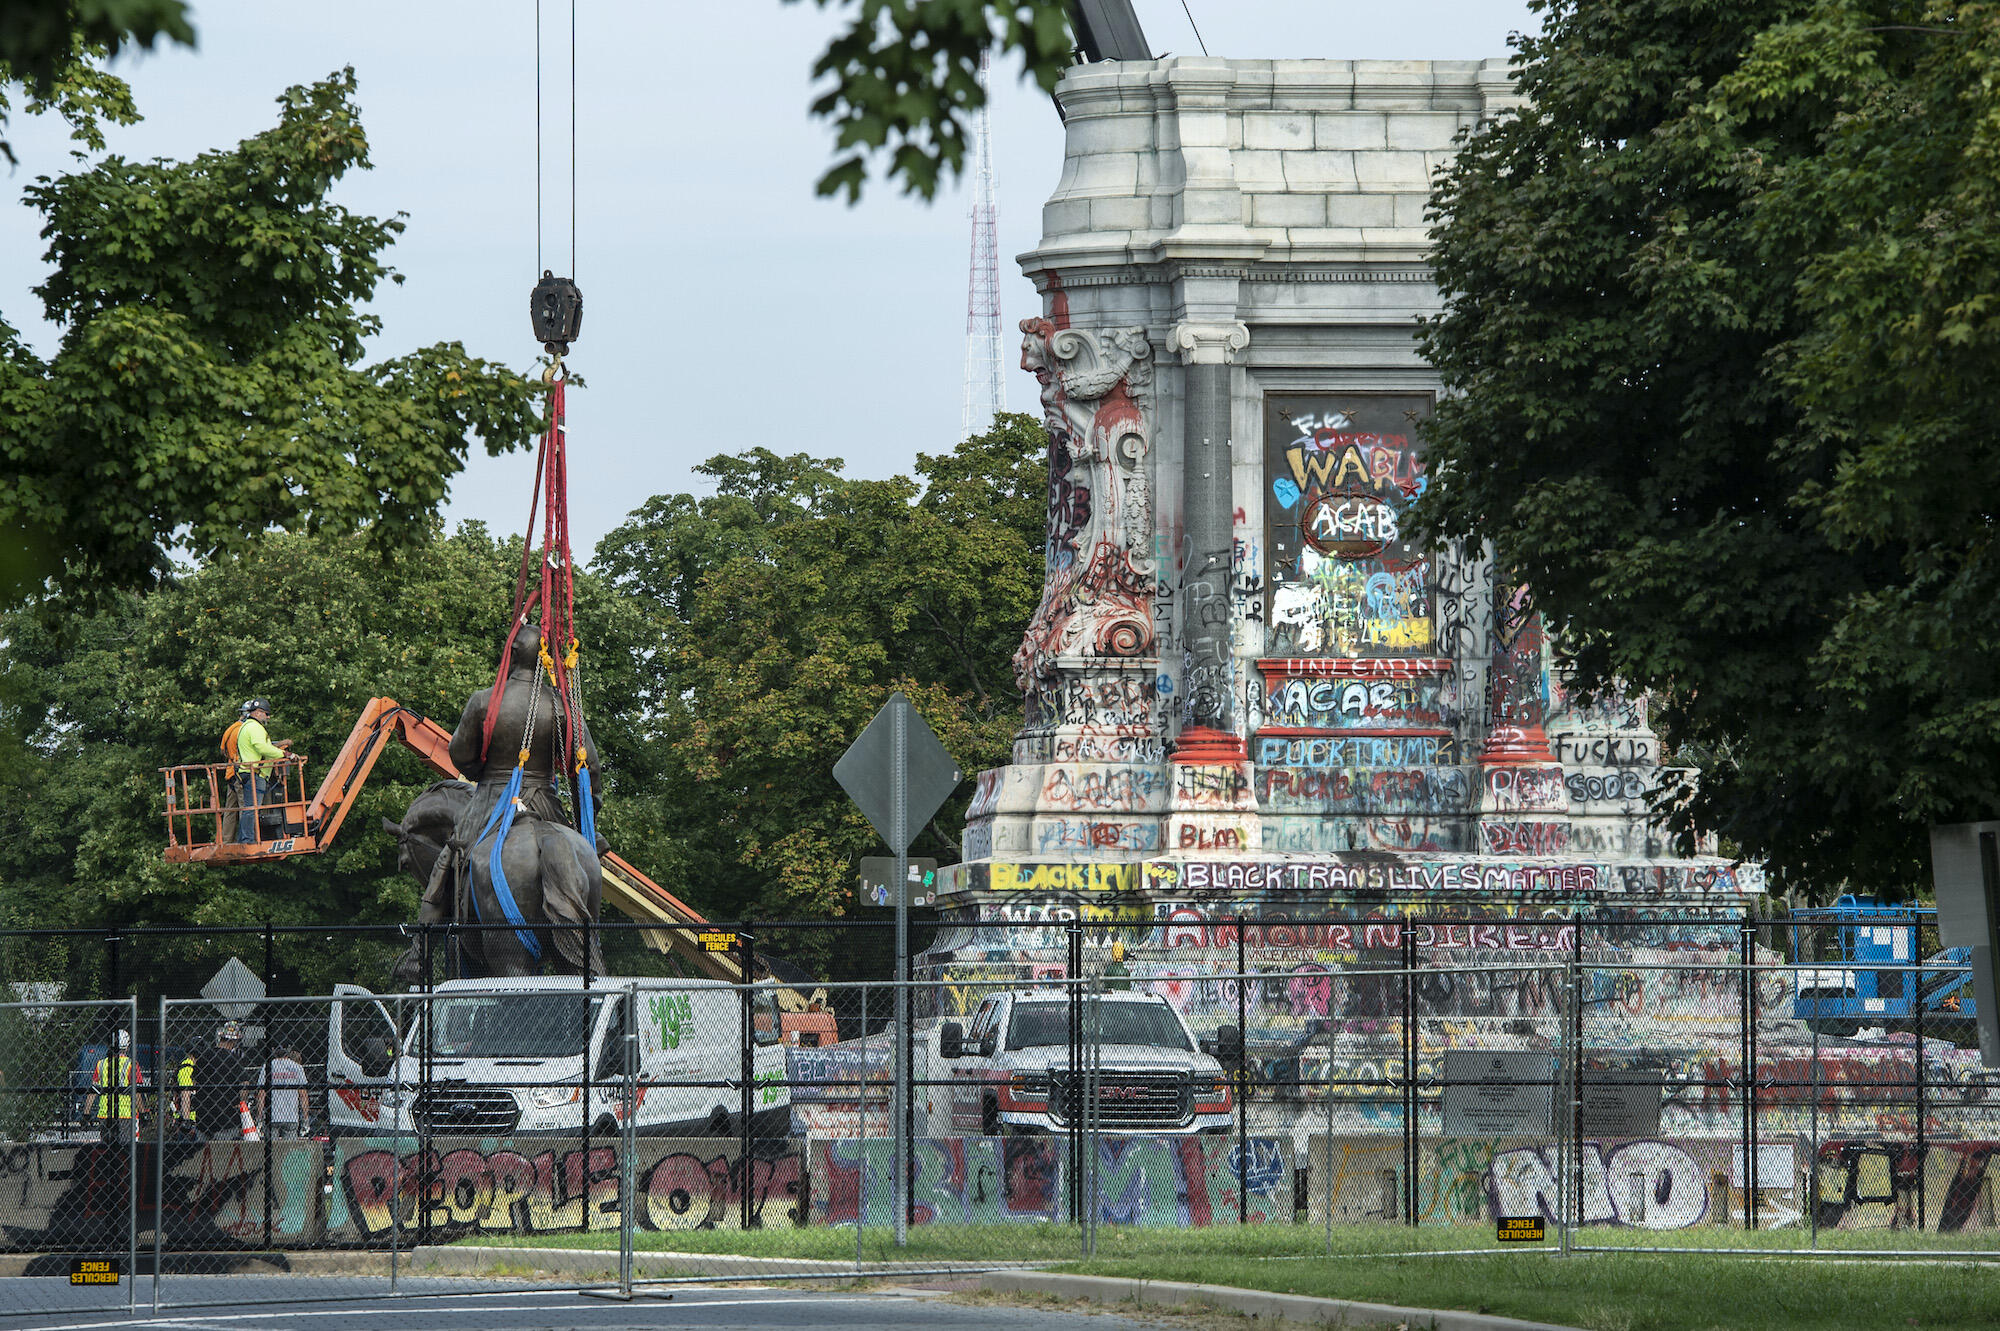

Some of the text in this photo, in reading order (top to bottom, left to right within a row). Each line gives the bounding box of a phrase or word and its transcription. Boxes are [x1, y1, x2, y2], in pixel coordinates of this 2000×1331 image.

[1311, 502, 1398, 539] ACAB
[1287, 658, 1438, 679] UNLEARN
[1284, 680, 1398, 719] ACAB
[1262, 738, 1438, 767] FUCK TRUMP
[1556, 732, 1651, 765] FUCK 12
[1179, 823, 1239, 849] BLM
[268, 838, 294, 853] JLG
[989, 863, 1084, 891] BLACK
[1186, 863, 1282, 889] BLACK
[1286, 863, 1384, 889] TRANS
[1388, 864, 1482, 890] LIVES
[1483, 866, 1598, 891] MATTER
[699, 933, 736, 942] HERCULES
[705, 942, 729, 951] FENCE
[1097, 1086, 1149, 1099] GMC
[1506, 1219, 1535, 1229] FENCE
[1498, 1229, 1543, 1240] HERCULES
[80, 1262, 110, 1272] FENCE
[71, 1272, 119, 1283] HERCULES
